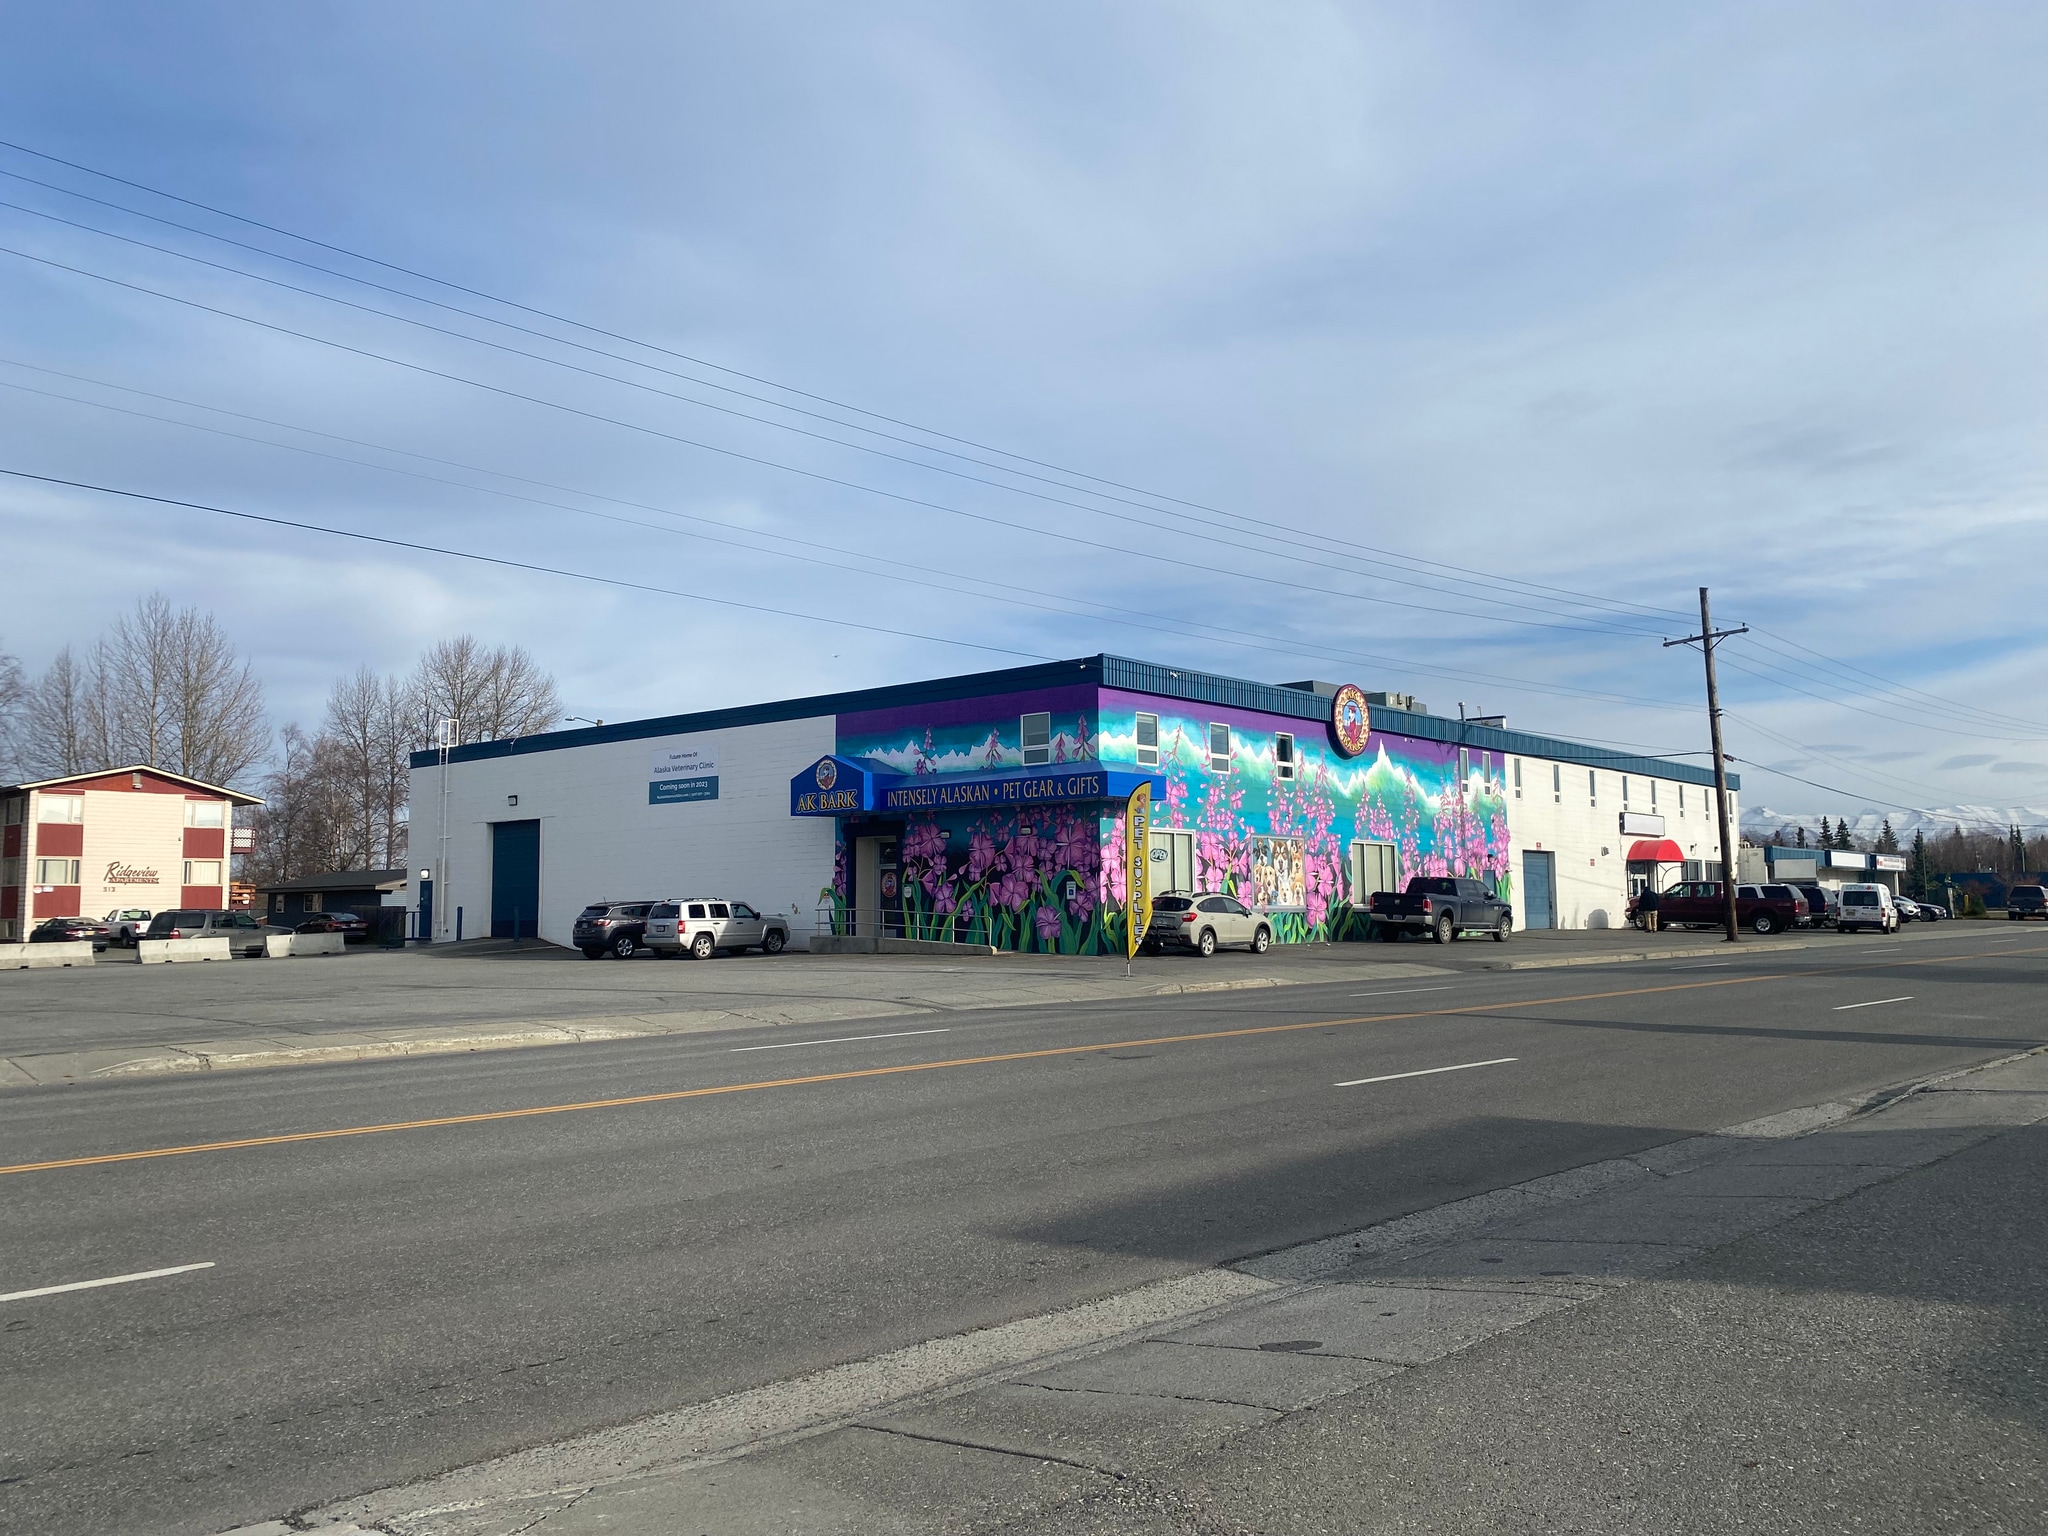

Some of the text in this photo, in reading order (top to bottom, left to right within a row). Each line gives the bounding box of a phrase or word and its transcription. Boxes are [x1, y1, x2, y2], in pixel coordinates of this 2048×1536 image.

[699, 761, 714, 769] Clinic
[796, 789, 858, 813] AK BARK
[887, 776, 1100, 807] INTENSELY ALASKAN PET GEAR & GIFTS
[1133, 815, 1146, 850] PET
[1151, 850, 1167, 860] OPEN
[103, 861, 158, 885] Ridgeview
